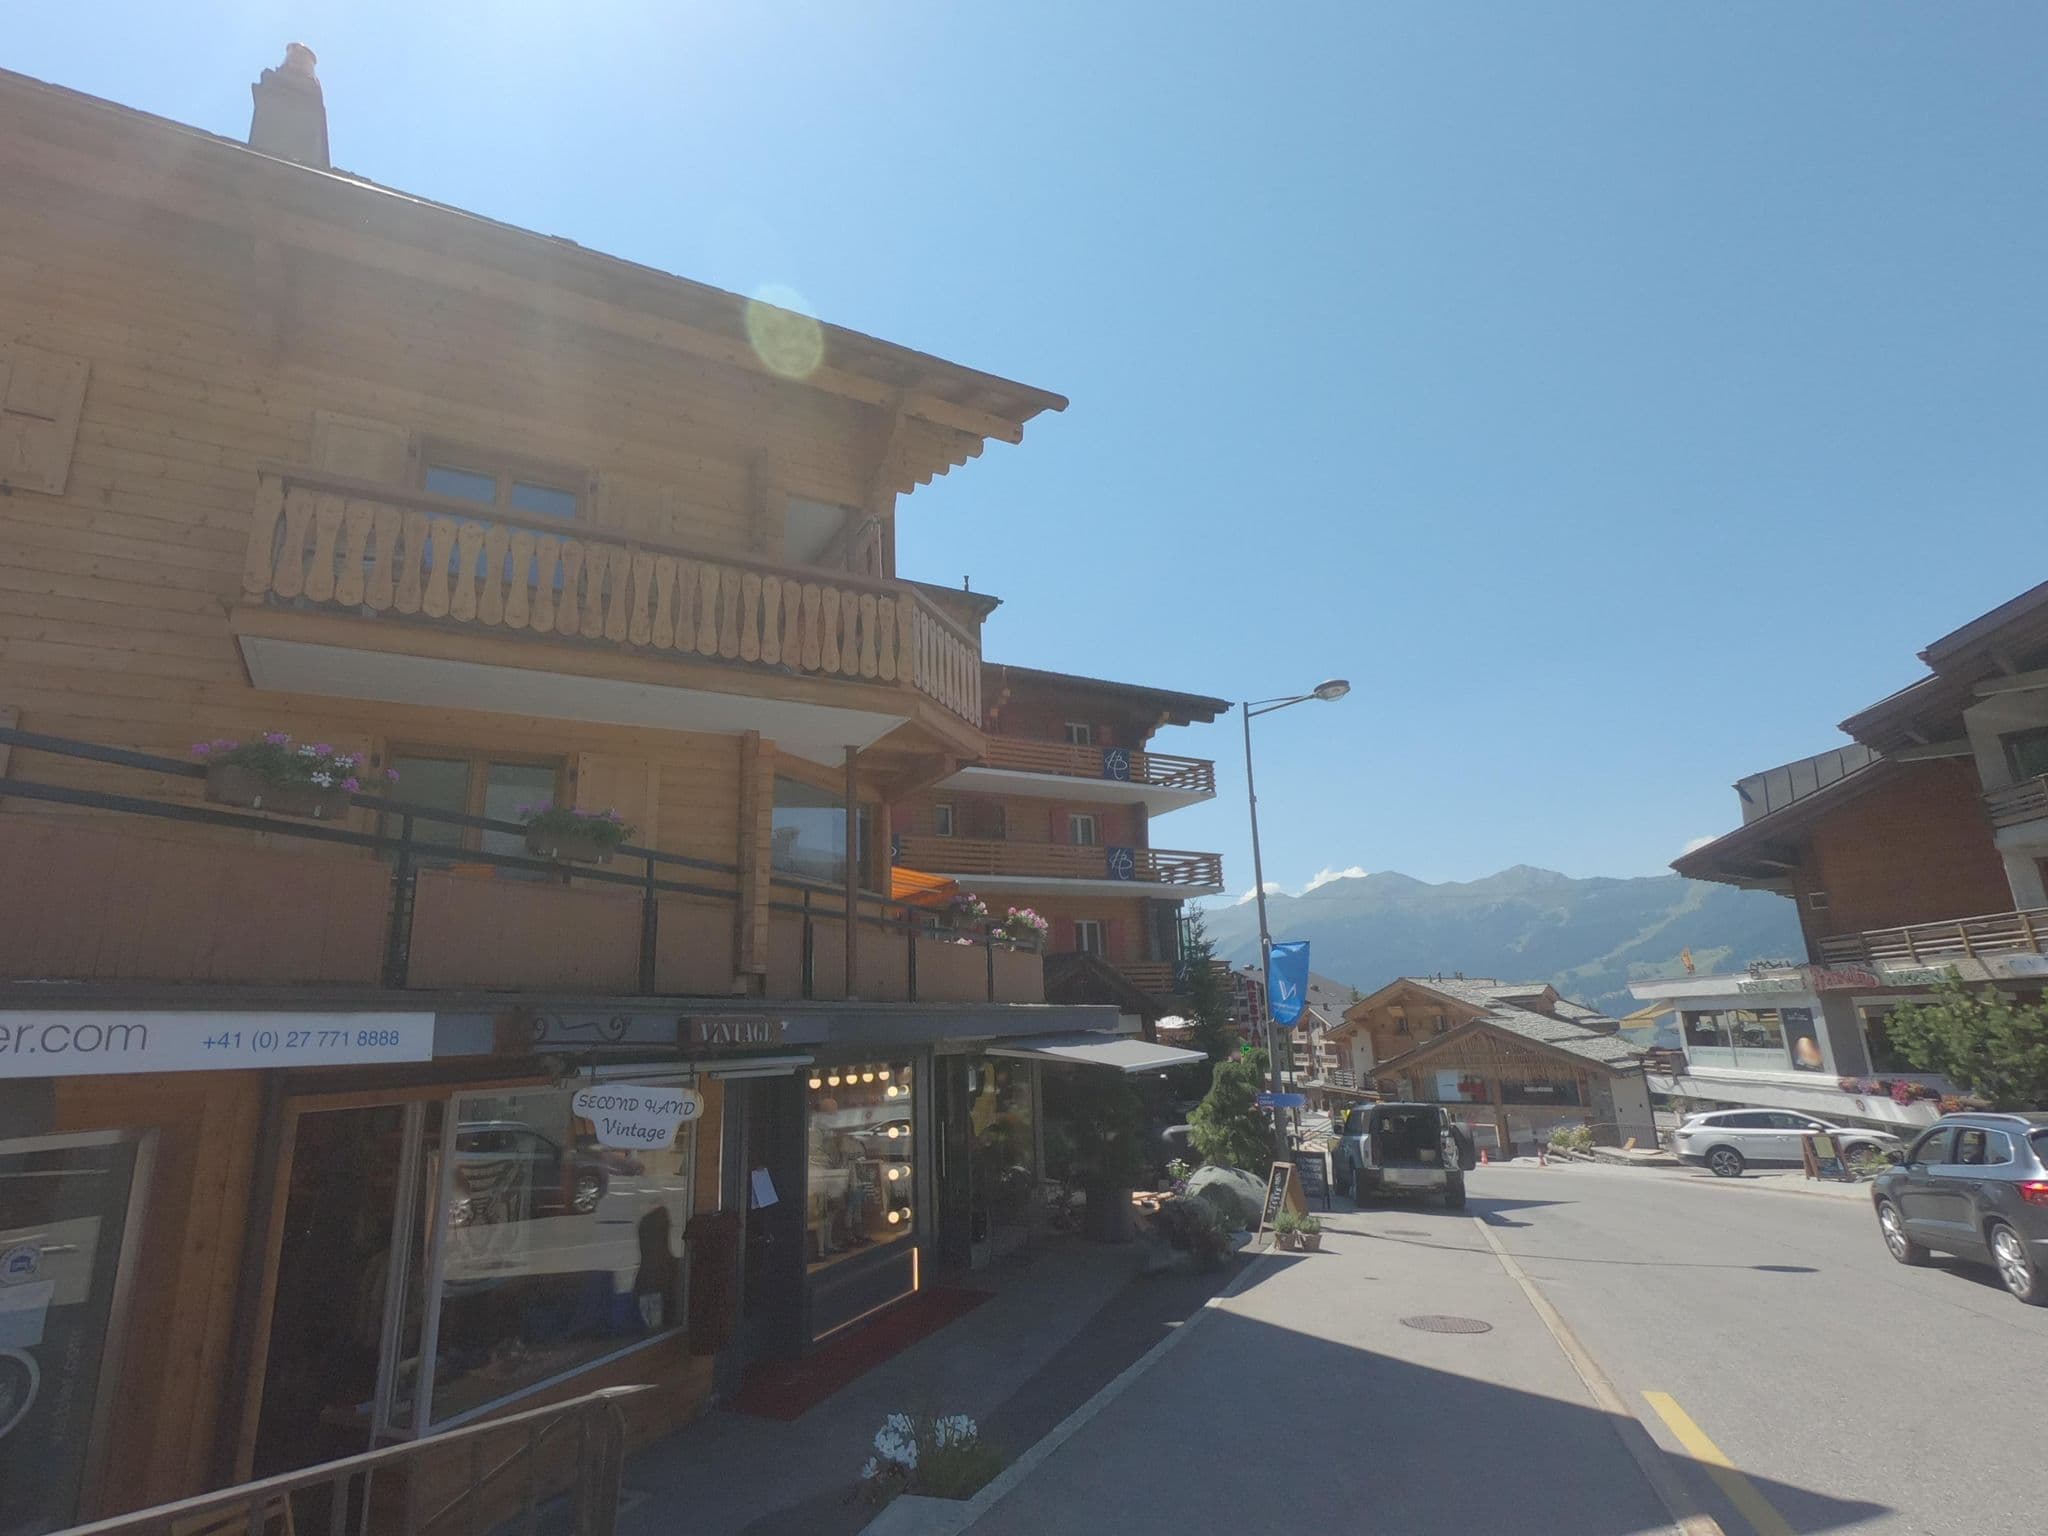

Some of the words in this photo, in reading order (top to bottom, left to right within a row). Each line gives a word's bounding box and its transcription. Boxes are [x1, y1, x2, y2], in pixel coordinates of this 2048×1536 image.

[202, 1031, 242, 1049] +41
[251, 1029, 279, 1052] (0)
[285, 1031, 311, 1048] 27
[318, 1031, 350, 1047] 771
[356, 1030, 400, 1047] 8888
[578, 1094, 640, 1112] SECOND
[644, 1098, 696, 1116] HAND
[601, 1117, 666, 1143] Vintage
